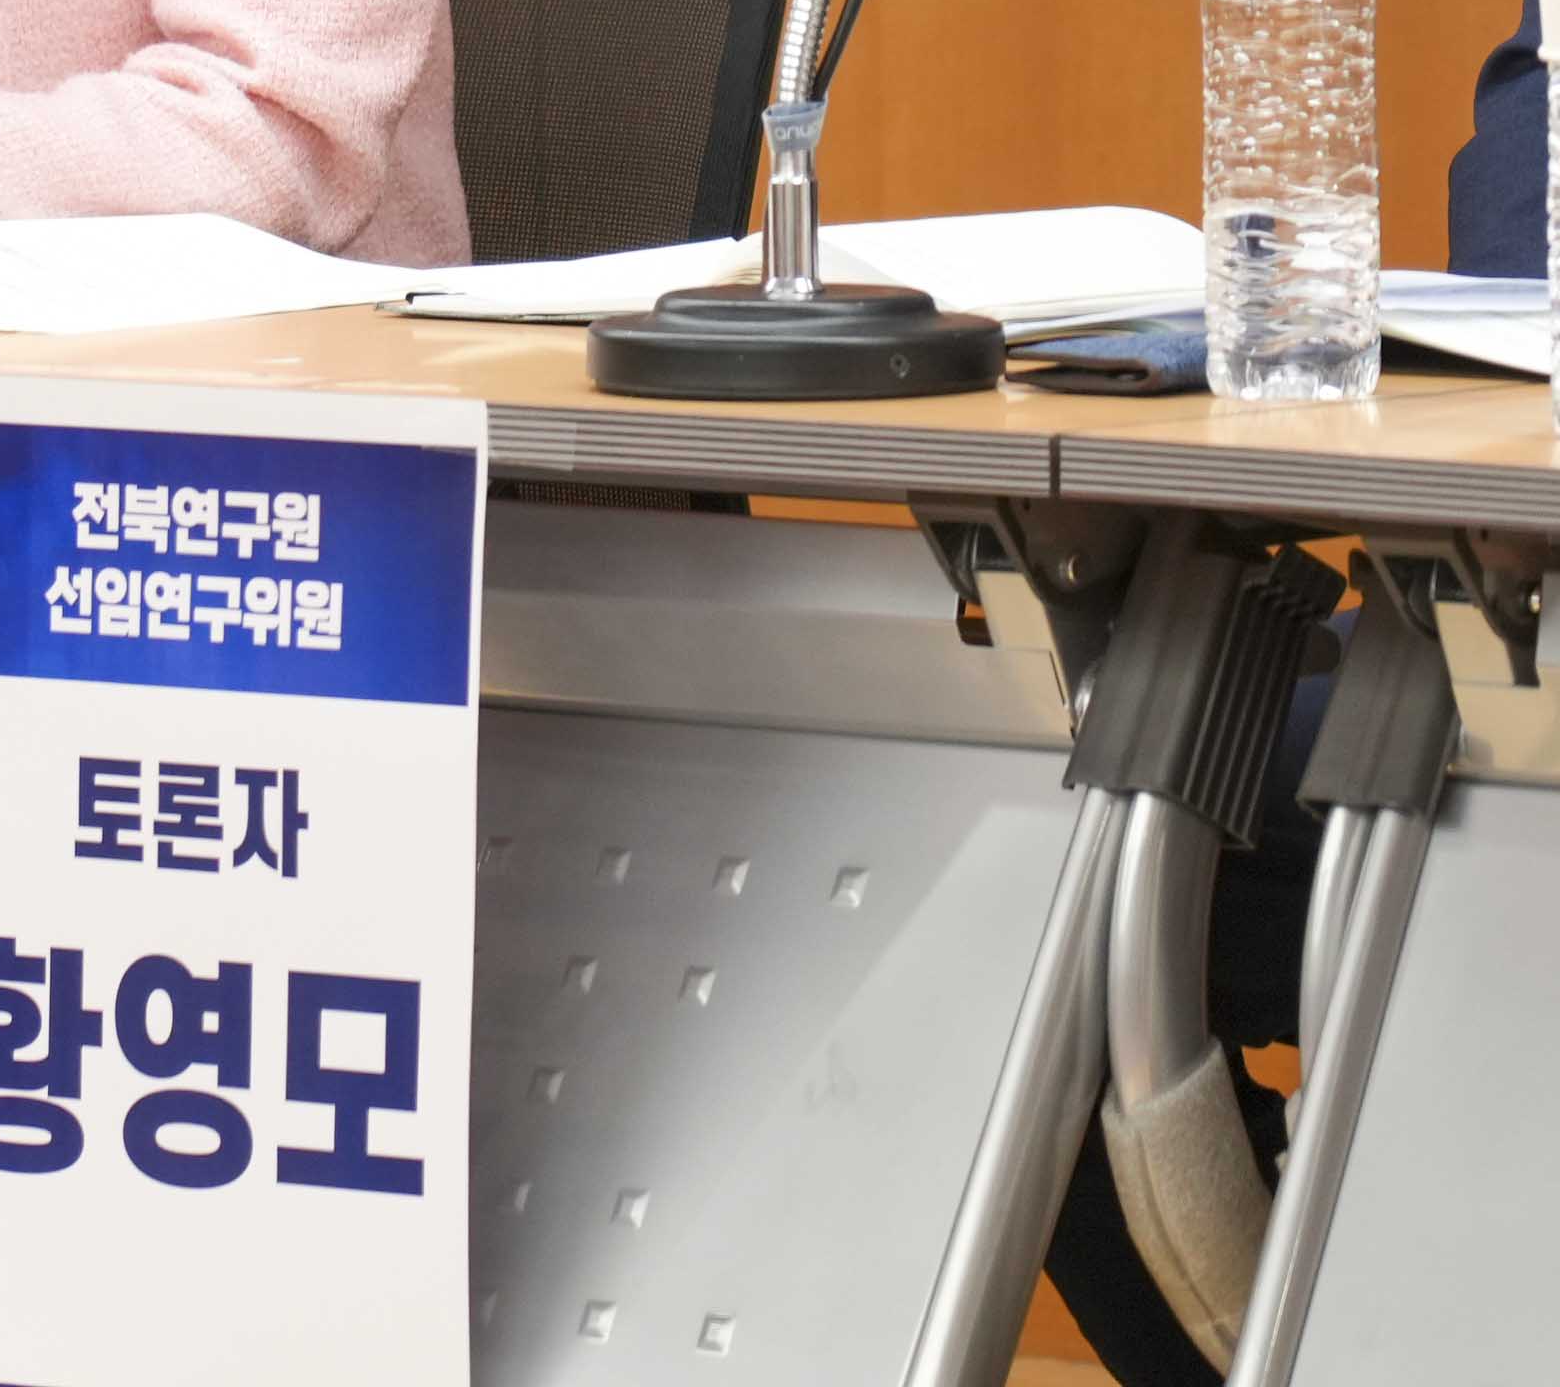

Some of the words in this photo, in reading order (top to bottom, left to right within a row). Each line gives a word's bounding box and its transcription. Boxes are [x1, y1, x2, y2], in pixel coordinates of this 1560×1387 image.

[71, 481, 321, 562] 전북연구원
[44, 565, 344, 651] 선임연구위원
[74, 756, 309, 879] 토론자
